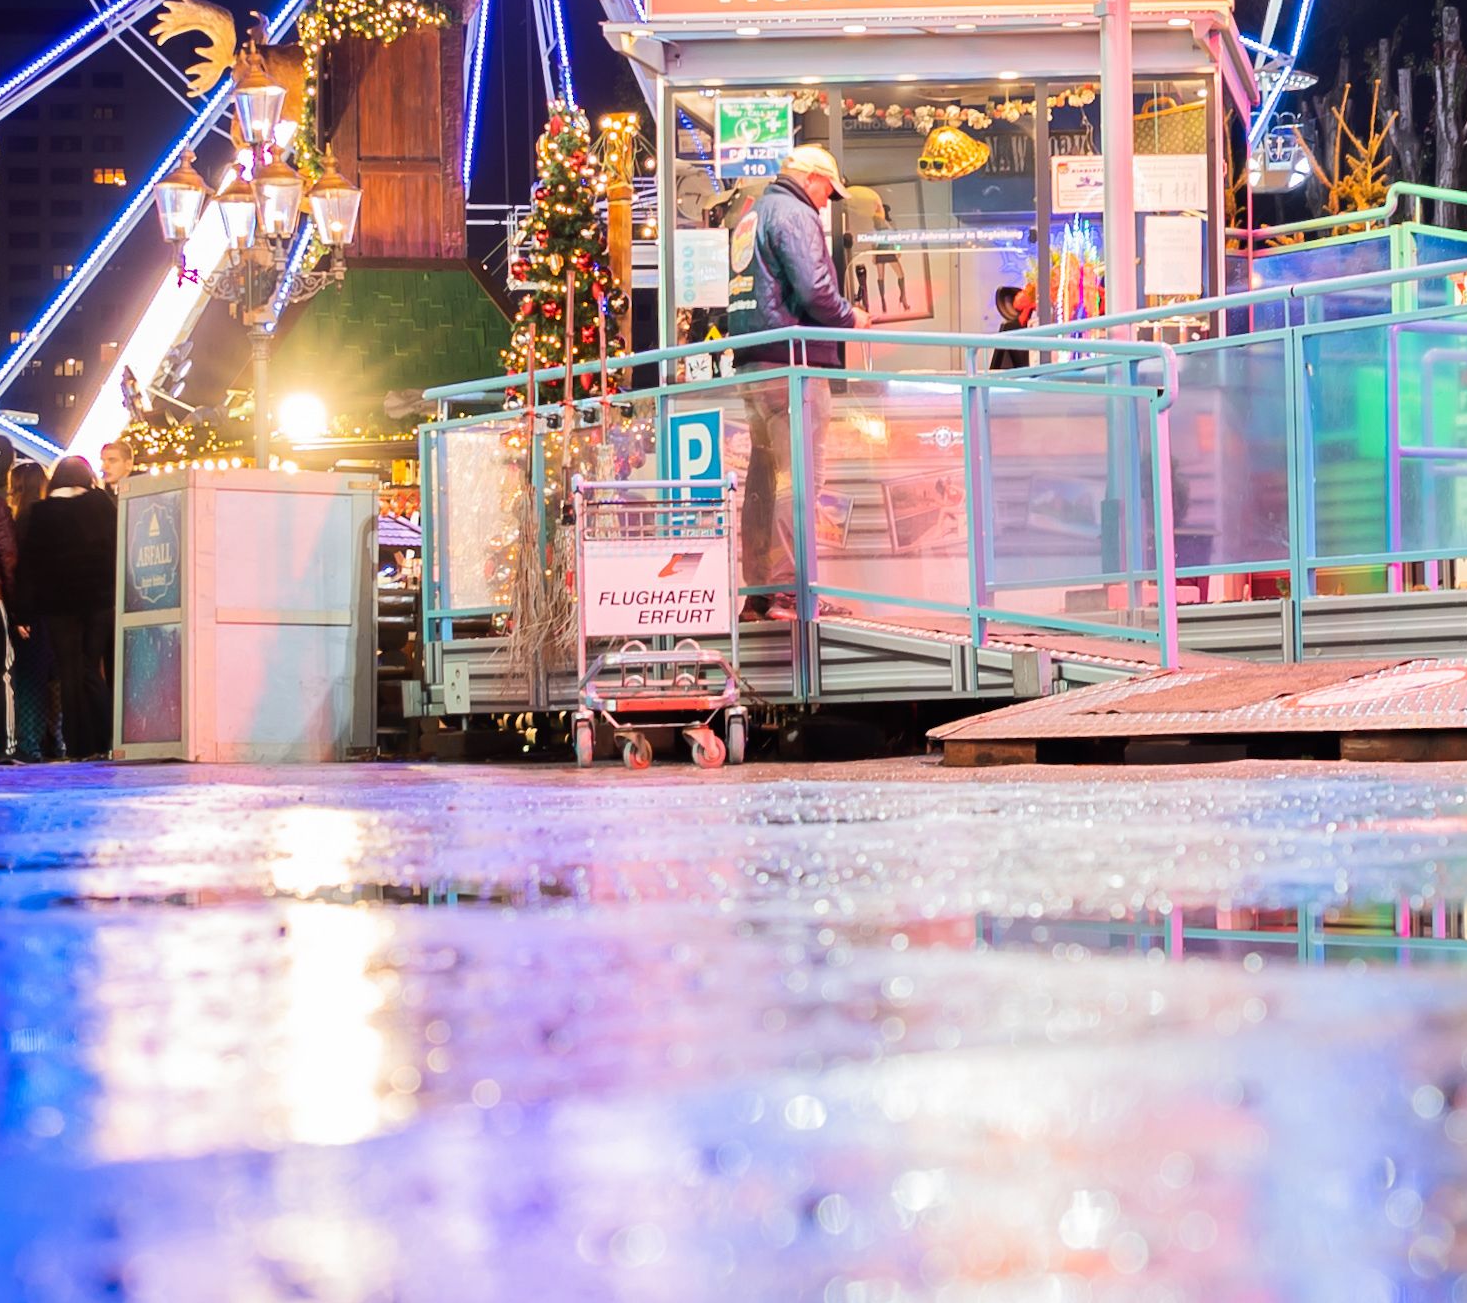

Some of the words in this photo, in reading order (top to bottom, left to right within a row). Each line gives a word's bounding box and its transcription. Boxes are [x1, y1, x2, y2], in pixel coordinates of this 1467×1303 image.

[729, 149, 780, 161] POLIZEI
[743, 165, 766, 176] 110
[858, 232, 885, 243] Kinder
[887, 233, 909, 242] unter
[919, 231, 949, 241] Jahren
[976, 229, 1023, 241] Begleitung
[679, 423, 712, 507] P
[136, 543, 172, 567] ABFALL
[599, 590, 715, 606] FLUGHAFEN
[638, 608, 715, 624] ERFURT
